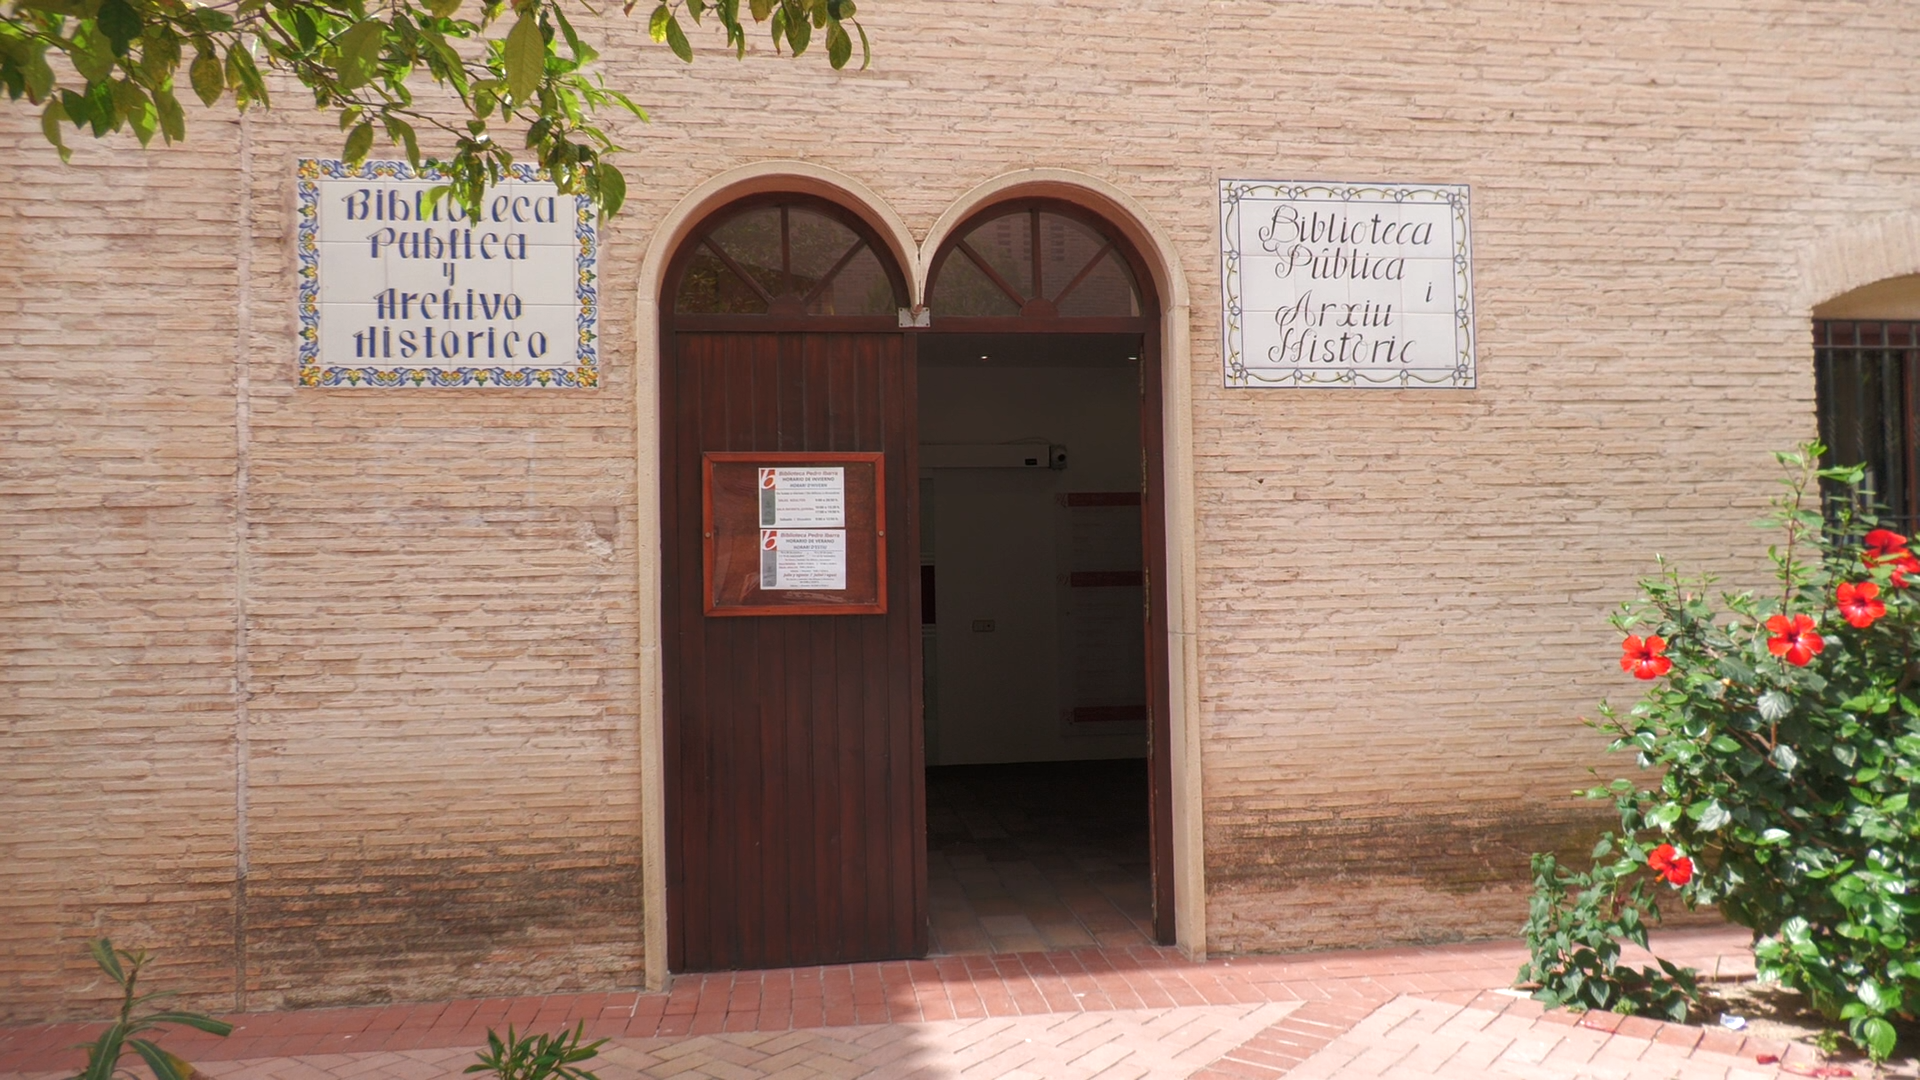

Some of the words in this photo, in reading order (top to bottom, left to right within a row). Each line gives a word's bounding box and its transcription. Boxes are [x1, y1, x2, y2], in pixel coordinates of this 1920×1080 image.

[341, 188, 557, 223] Biblioeca
[1258, 204, 1433, 246] Biblioteca
[366, 227, 530, 260] Publica
[442, 262, 455, 286] y
[1275, 244, 1406, 280] Pública
[373, 288, 522, 321] Archivo
[1275, 289, 1394, 327] Arxiu
[1425, 281, 1433, 303] i
[352, 326, 547, 358] Historico
